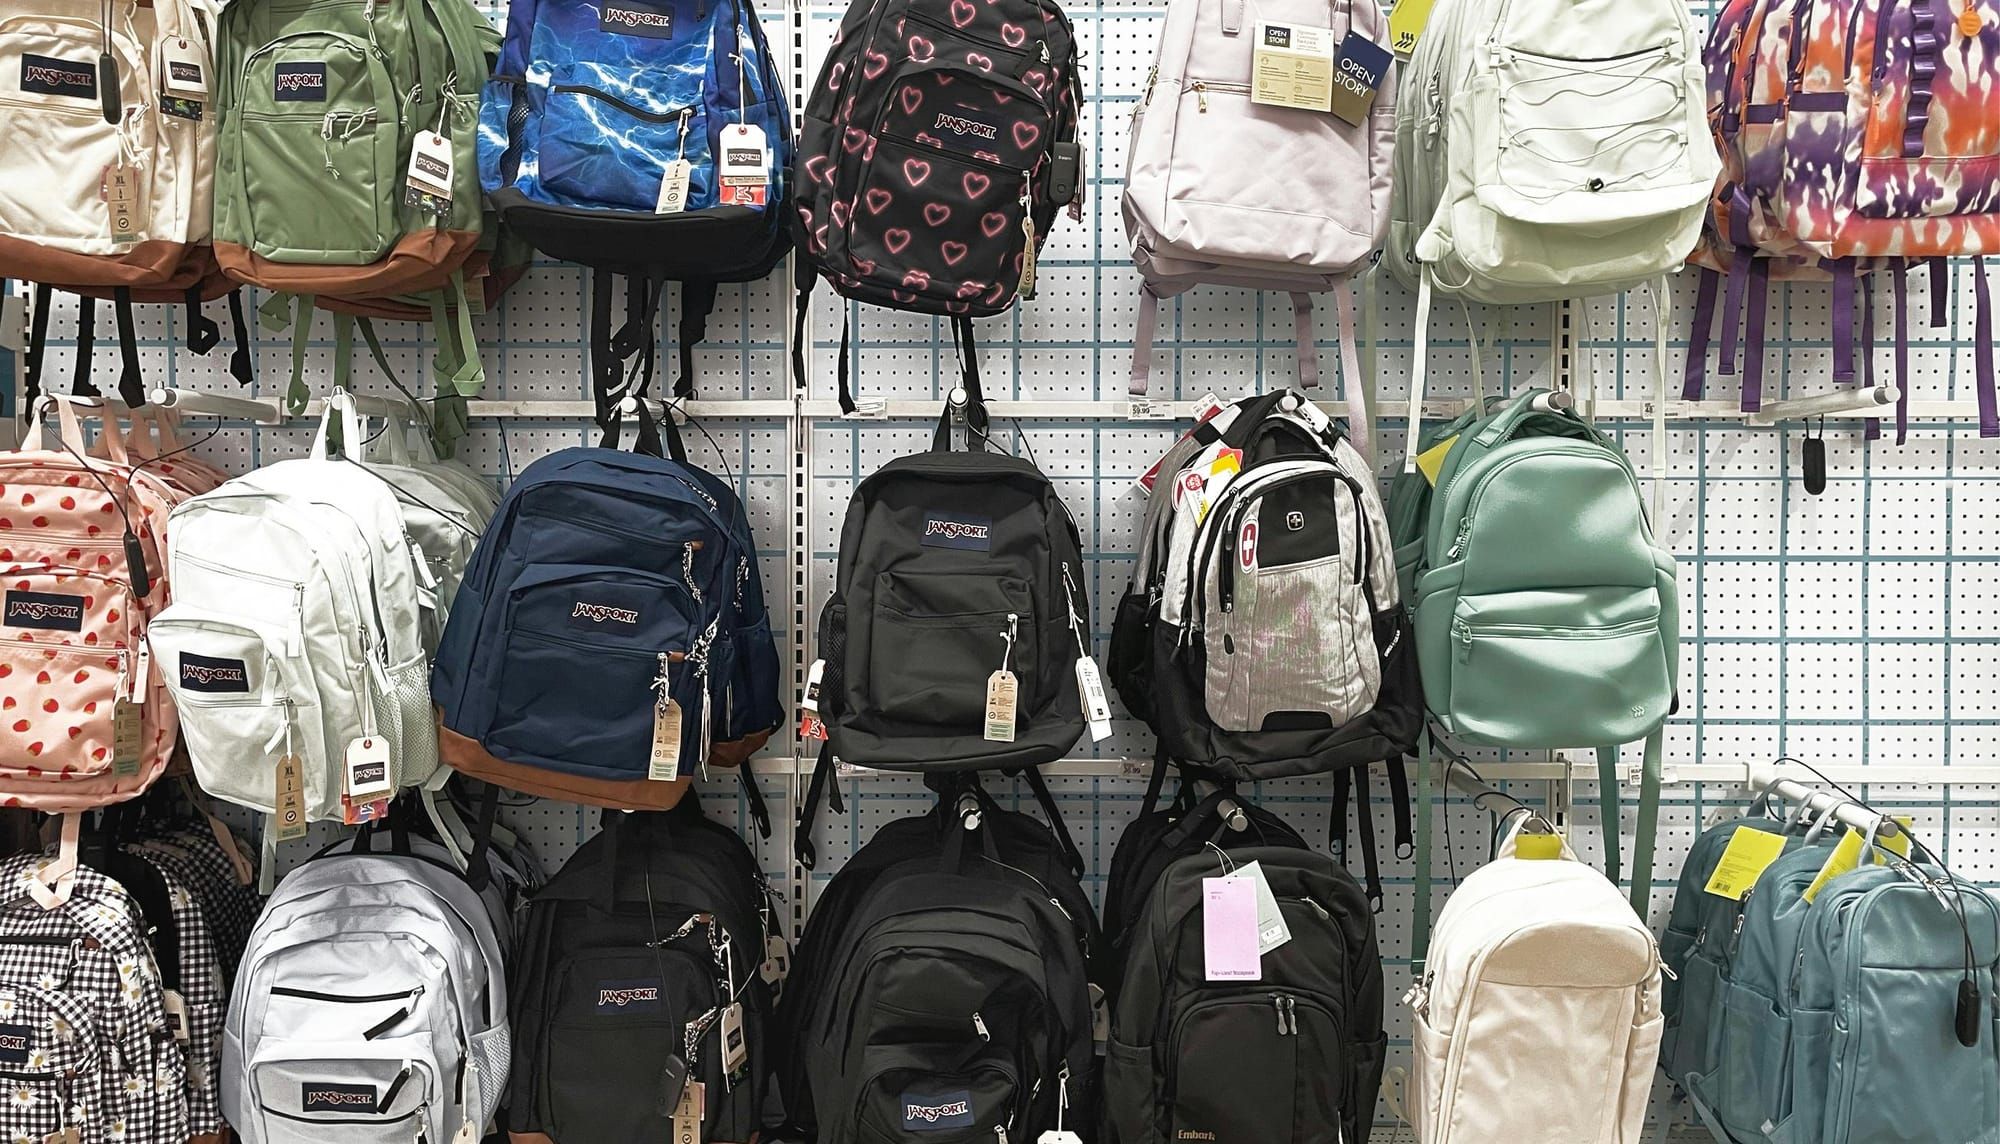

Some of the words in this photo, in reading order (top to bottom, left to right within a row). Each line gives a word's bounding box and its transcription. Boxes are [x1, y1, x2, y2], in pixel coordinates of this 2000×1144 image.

[605, 8, 669, 27] JANSPORT
[26, 65, 92, 86] JANSPORT
[1341, 57, 1375, 85] OPEN
[277, 73, 322, 91] JANSPORT
[1334, 70, 1369, 98] STORY
[935, 112, 997, 141] JANSPORT
[925, 520, 988, 539] JANSPORT
[9, 601, 78, 620] JANSPORT
[572, 601, 638, 624] JANSPORT
[183, 663, 243, 684] JANSPORT
[598, 987, 658, 1006] JANSPORT
[307, 1090, 373, 1105] JANSPORT
[906, 1101, 968, 1123] JANSPORT
[1178, 1129, 1216, 1141] Embark
